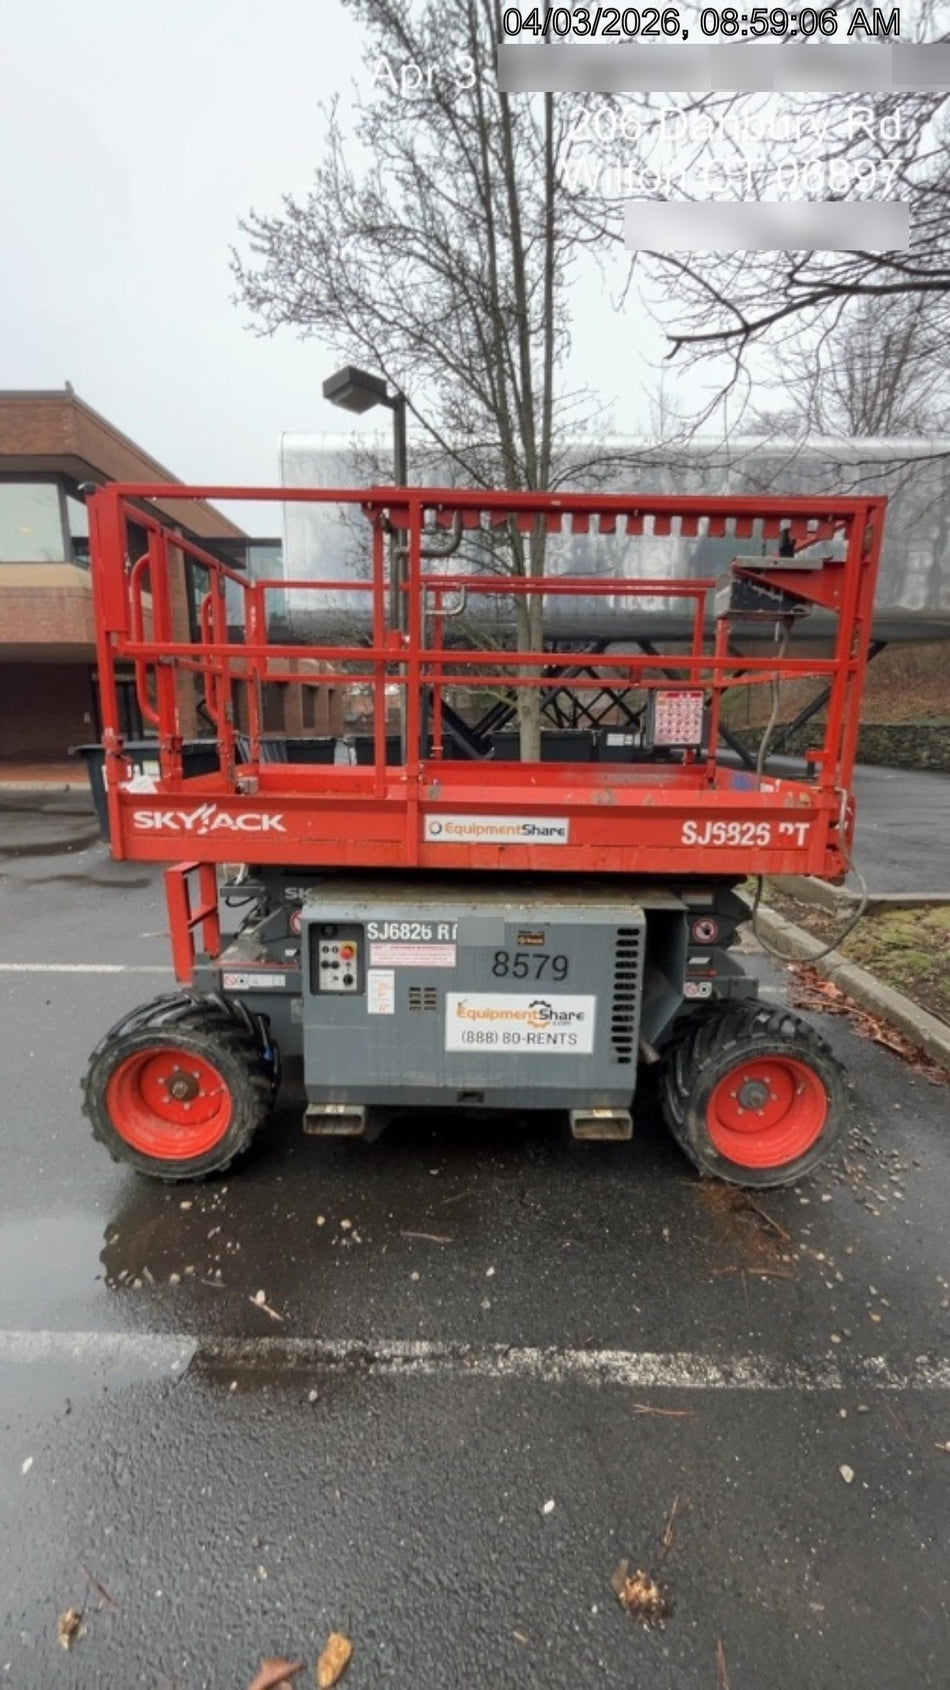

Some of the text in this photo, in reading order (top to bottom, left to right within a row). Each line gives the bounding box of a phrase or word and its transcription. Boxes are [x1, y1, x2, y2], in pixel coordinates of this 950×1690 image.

[133, 803, 287, 835] SKYJACK
[445, 822, 566, 836] EquipmentShare
[681, 820, 771, 846] SJ6826
[367, 922, 433, 940] SJ6826
[492, 951, 569, 981] 8579
[456, 1006, 585, 1021] EquipmentShare
[461, 1030, 578, 1046] (888) 80-RENTS
